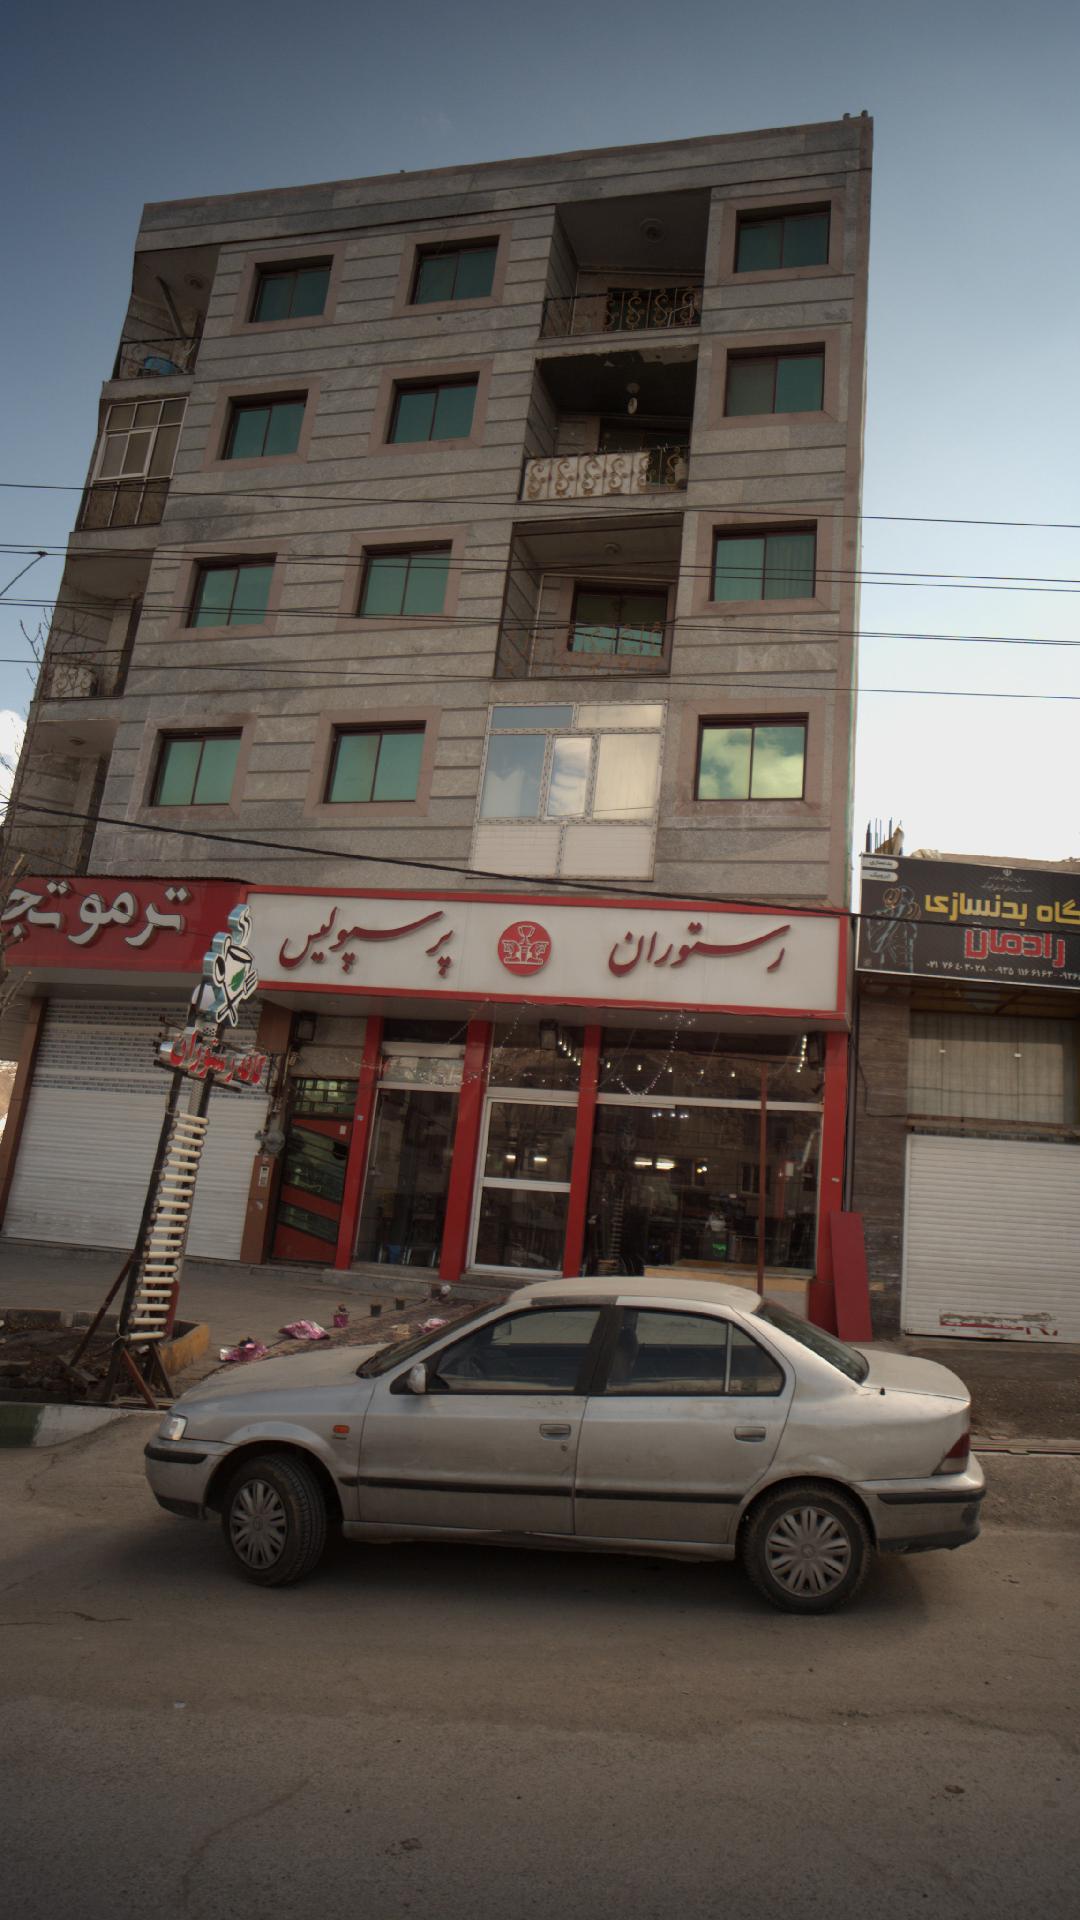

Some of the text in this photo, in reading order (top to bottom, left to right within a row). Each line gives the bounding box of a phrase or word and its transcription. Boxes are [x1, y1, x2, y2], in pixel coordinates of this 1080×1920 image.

[68, 886, 189, 947] ترمو
[924, 891, 1028, 927] بدنسازی
[278, 905, 792, 980] رستوران پرسپولیس
[964, 922, 1066, 969] رادمان
